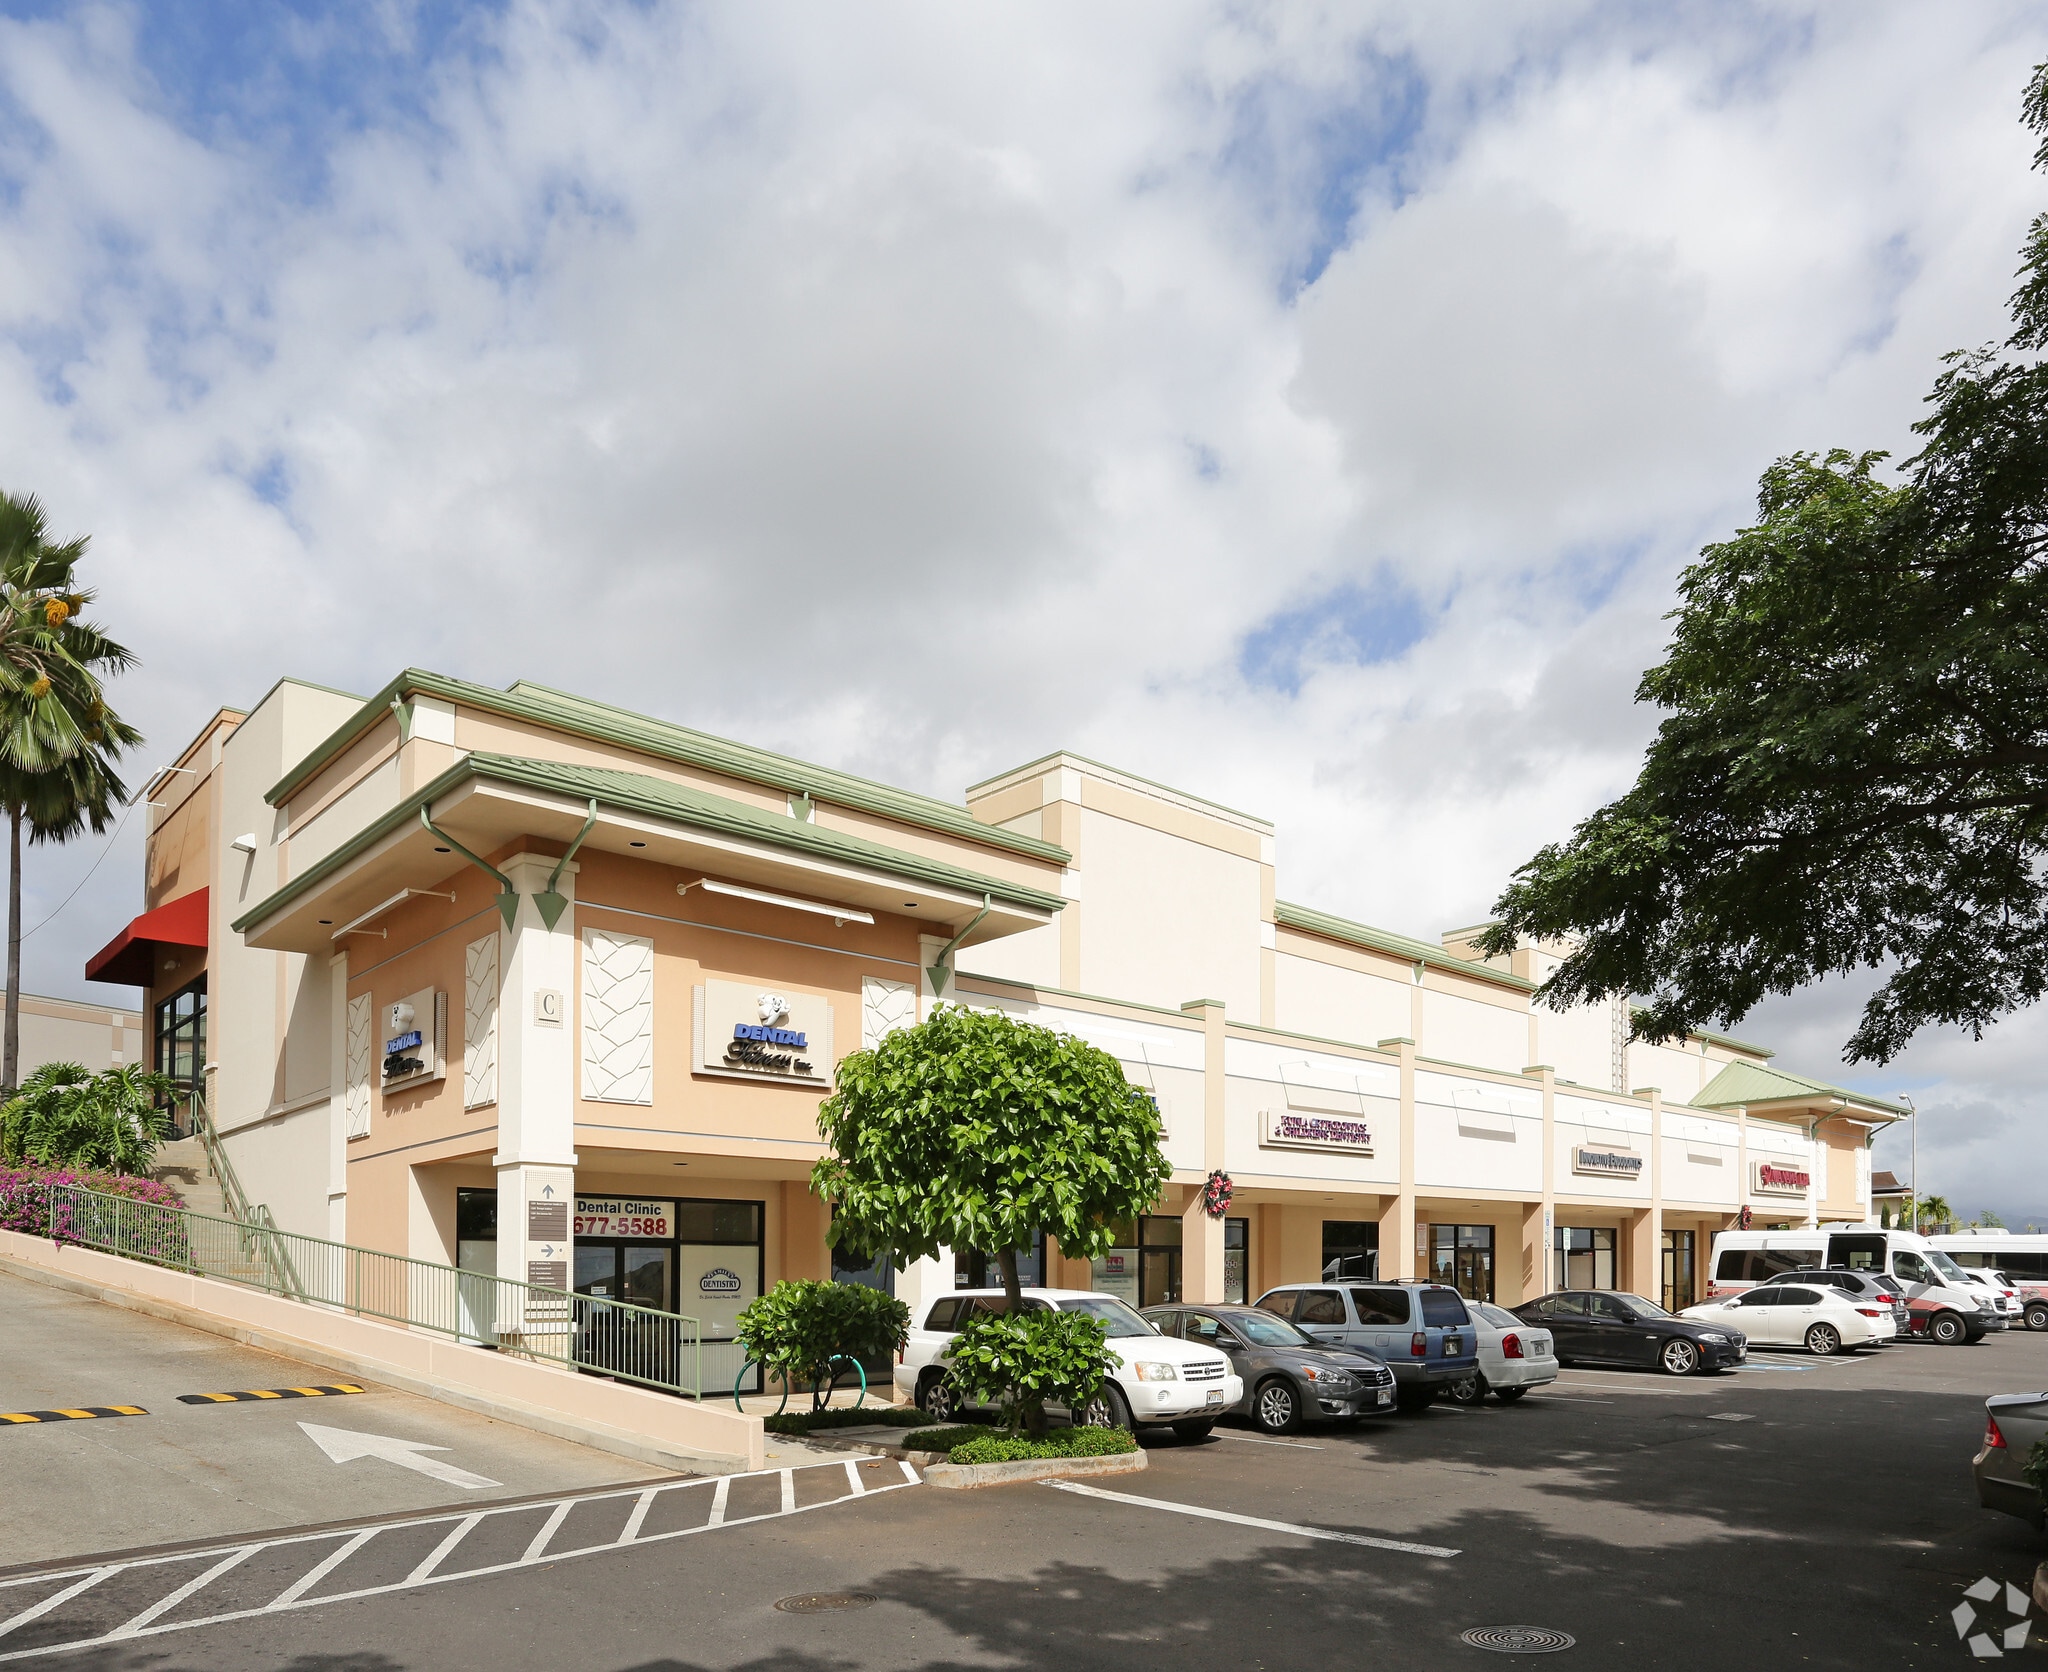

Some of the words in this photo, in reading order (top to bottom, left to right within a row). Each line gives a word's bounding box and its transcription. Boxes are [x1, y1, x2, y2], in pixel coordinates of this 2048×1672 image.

[543, 993, 555, 1016] C
[386, 1030, 422, 1055] DENTAL
[733, 1023, 808, 1047] DENTAL
[577, 1200, 621, 1214] Dental
[624, 1202, 662, 1215] Clinic
[573, 1215, 668, 1236] 677-5588
[703, 1280, 737, 1288] DENTISTRY
